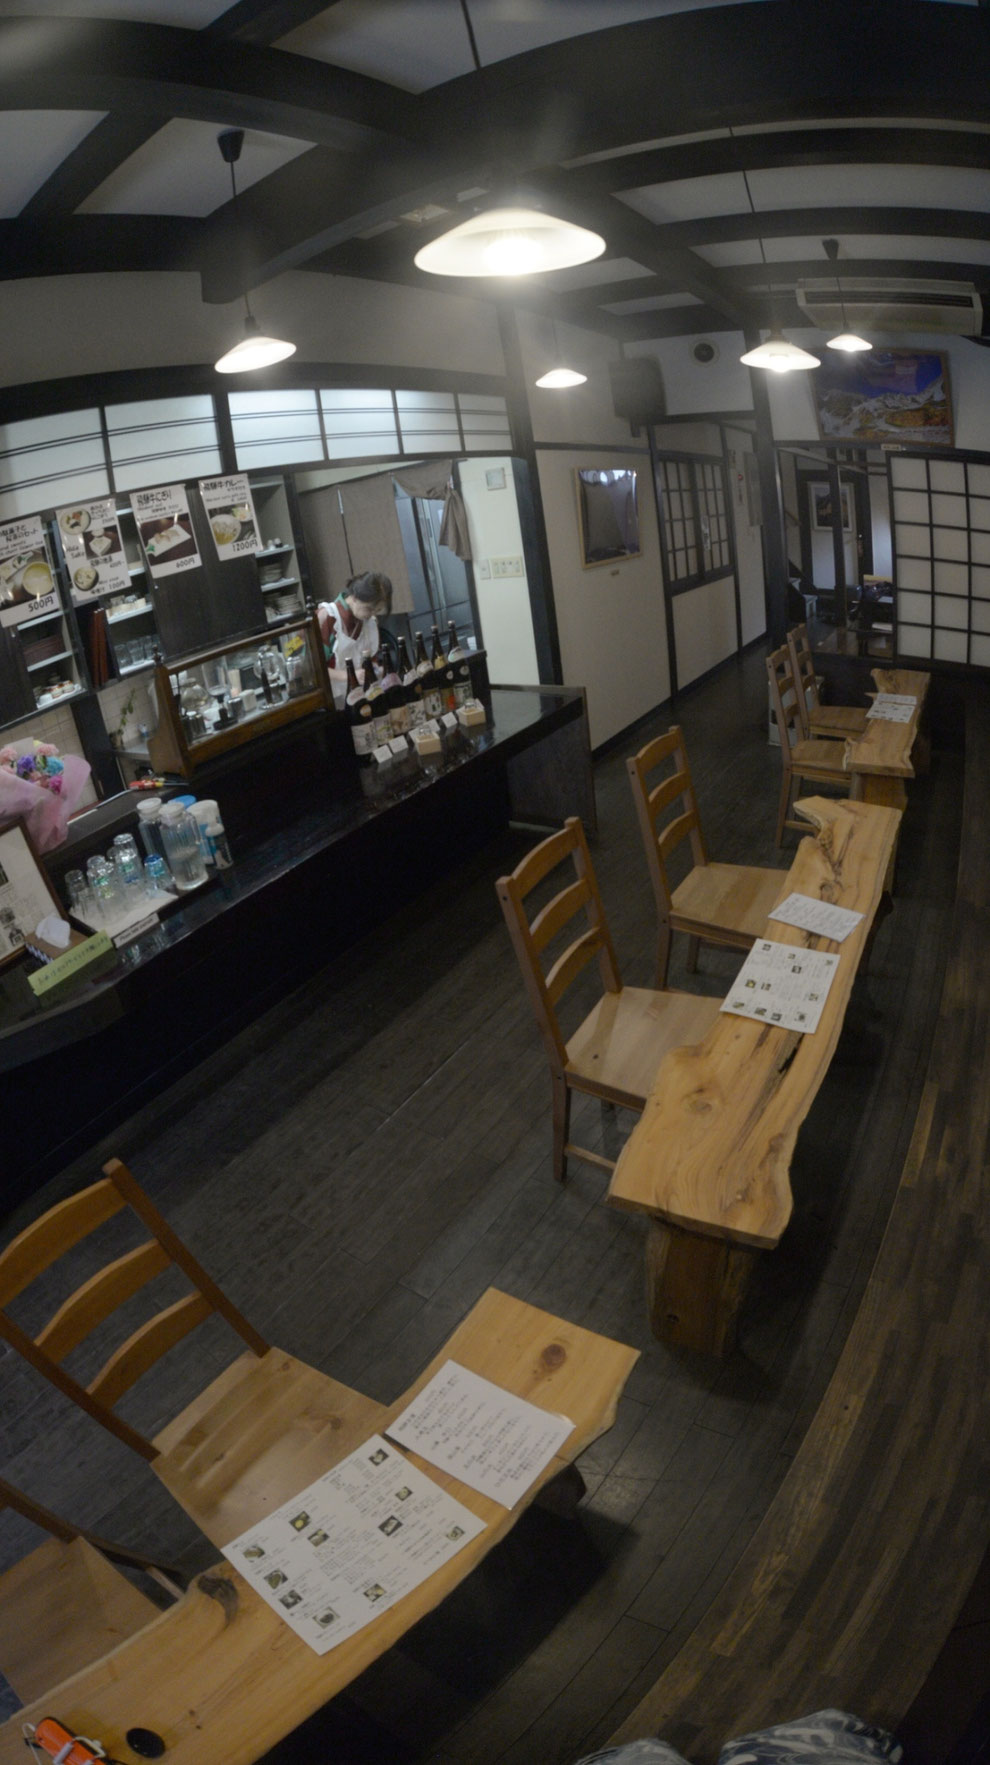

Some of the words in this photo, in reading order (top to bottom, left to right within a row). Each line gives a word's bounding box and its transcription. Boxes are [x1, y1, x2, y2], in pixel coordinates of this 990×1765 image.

[232, 539, 258, 552] 1200円
[176, 558, 195, 568] 600円
[28, 596, 54, 612] 500円
